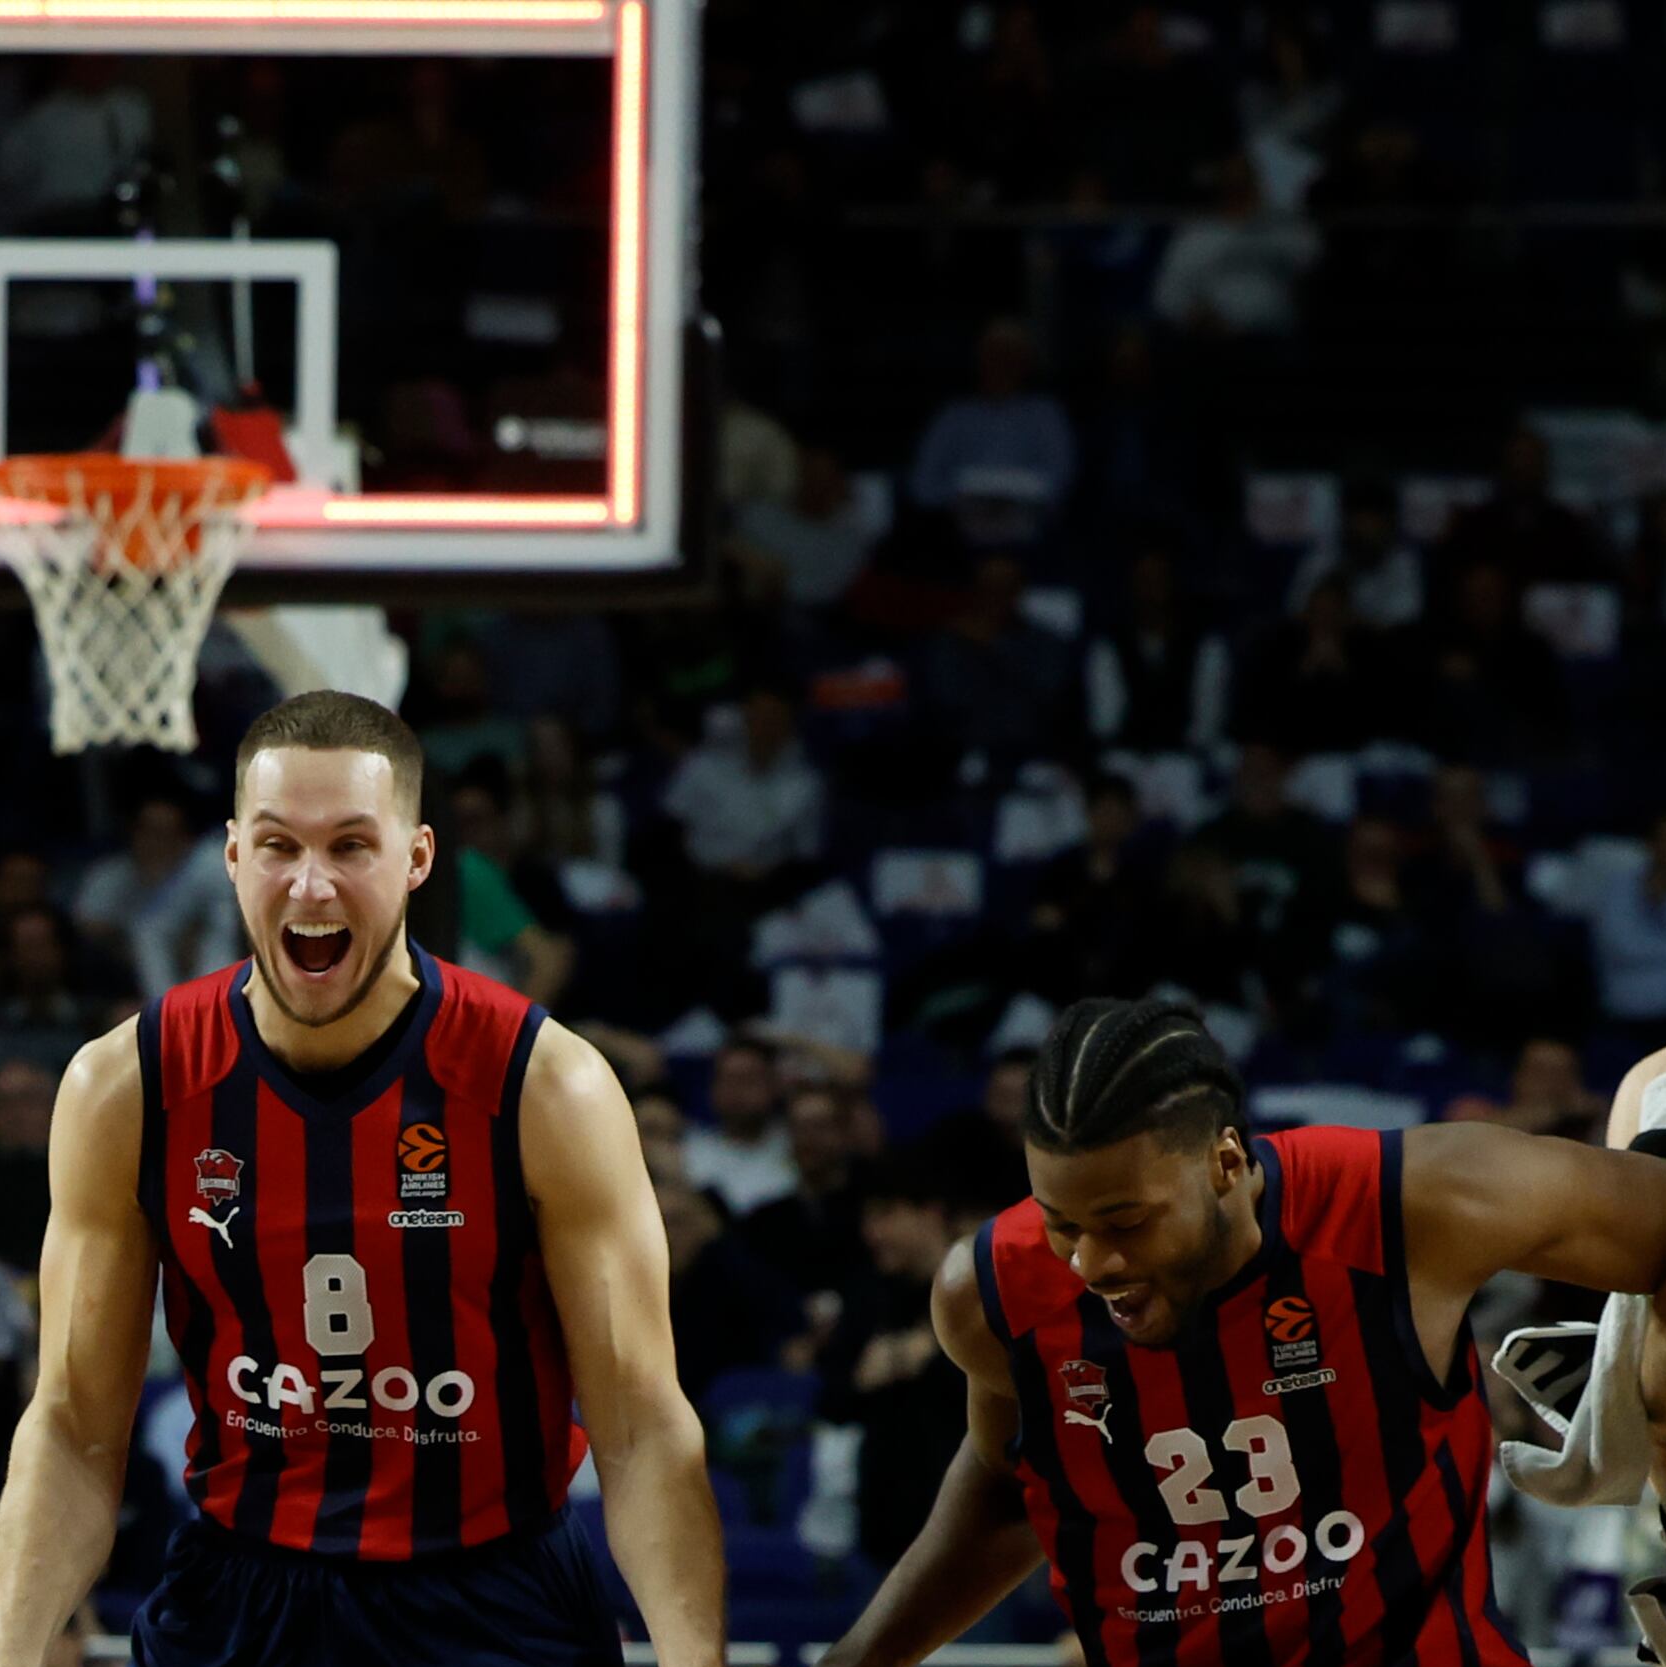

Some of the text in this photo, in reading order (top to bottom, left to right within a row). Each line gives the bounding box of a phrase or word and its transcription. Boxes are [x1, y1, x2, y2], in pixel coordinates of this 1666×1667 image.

[388, 1208, 465, 1228] oneteam
[303, 1254, 374, 1356] 8
[227, 1355, 475, 1418] CAZOO
[1144, 1414, 1302, 1526] 23
[1121, 1511, 1365, 1593] CAZOO
